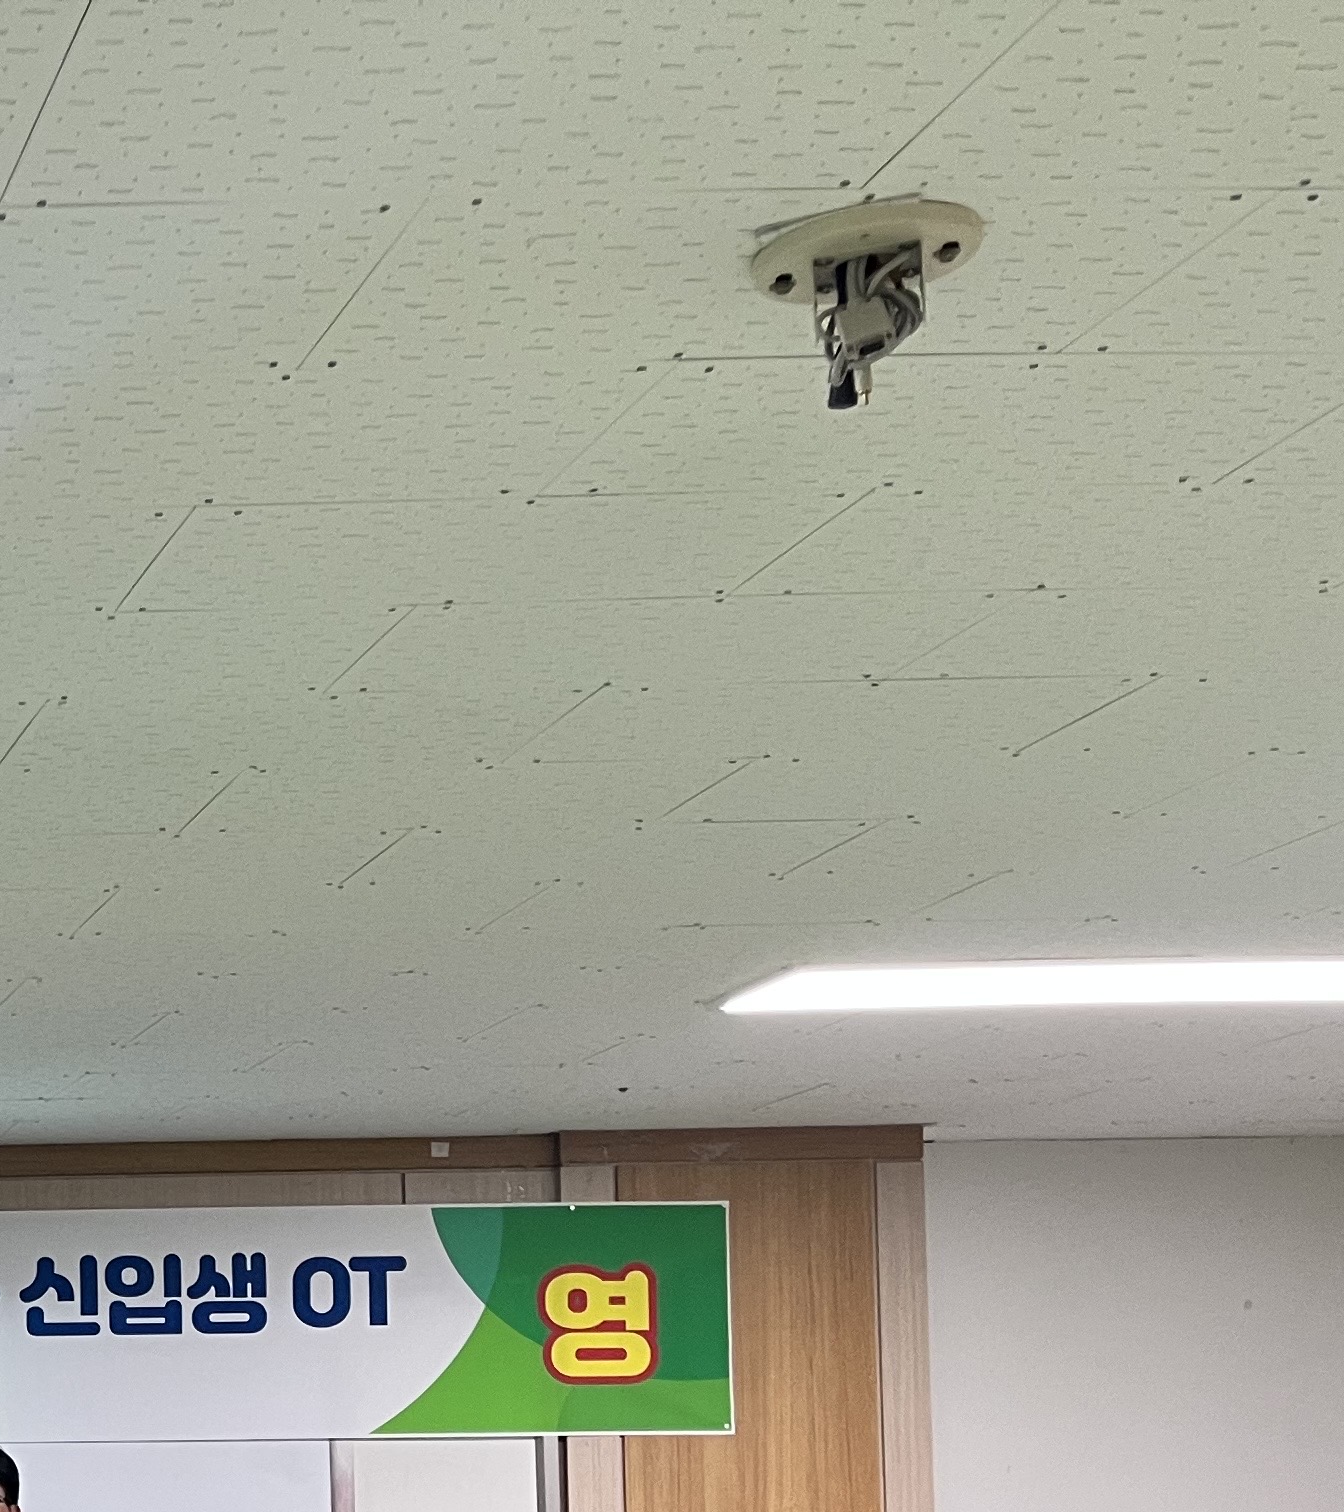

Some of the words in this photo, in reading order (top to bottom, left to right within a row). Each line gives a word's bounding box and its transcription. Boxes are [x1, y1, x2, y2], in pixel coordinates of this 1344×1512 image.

[21, 1254, 268, 1337] 신입생
[293, 1256, 407, 1328] OT
[542, 1265, 654, 1380] 영
